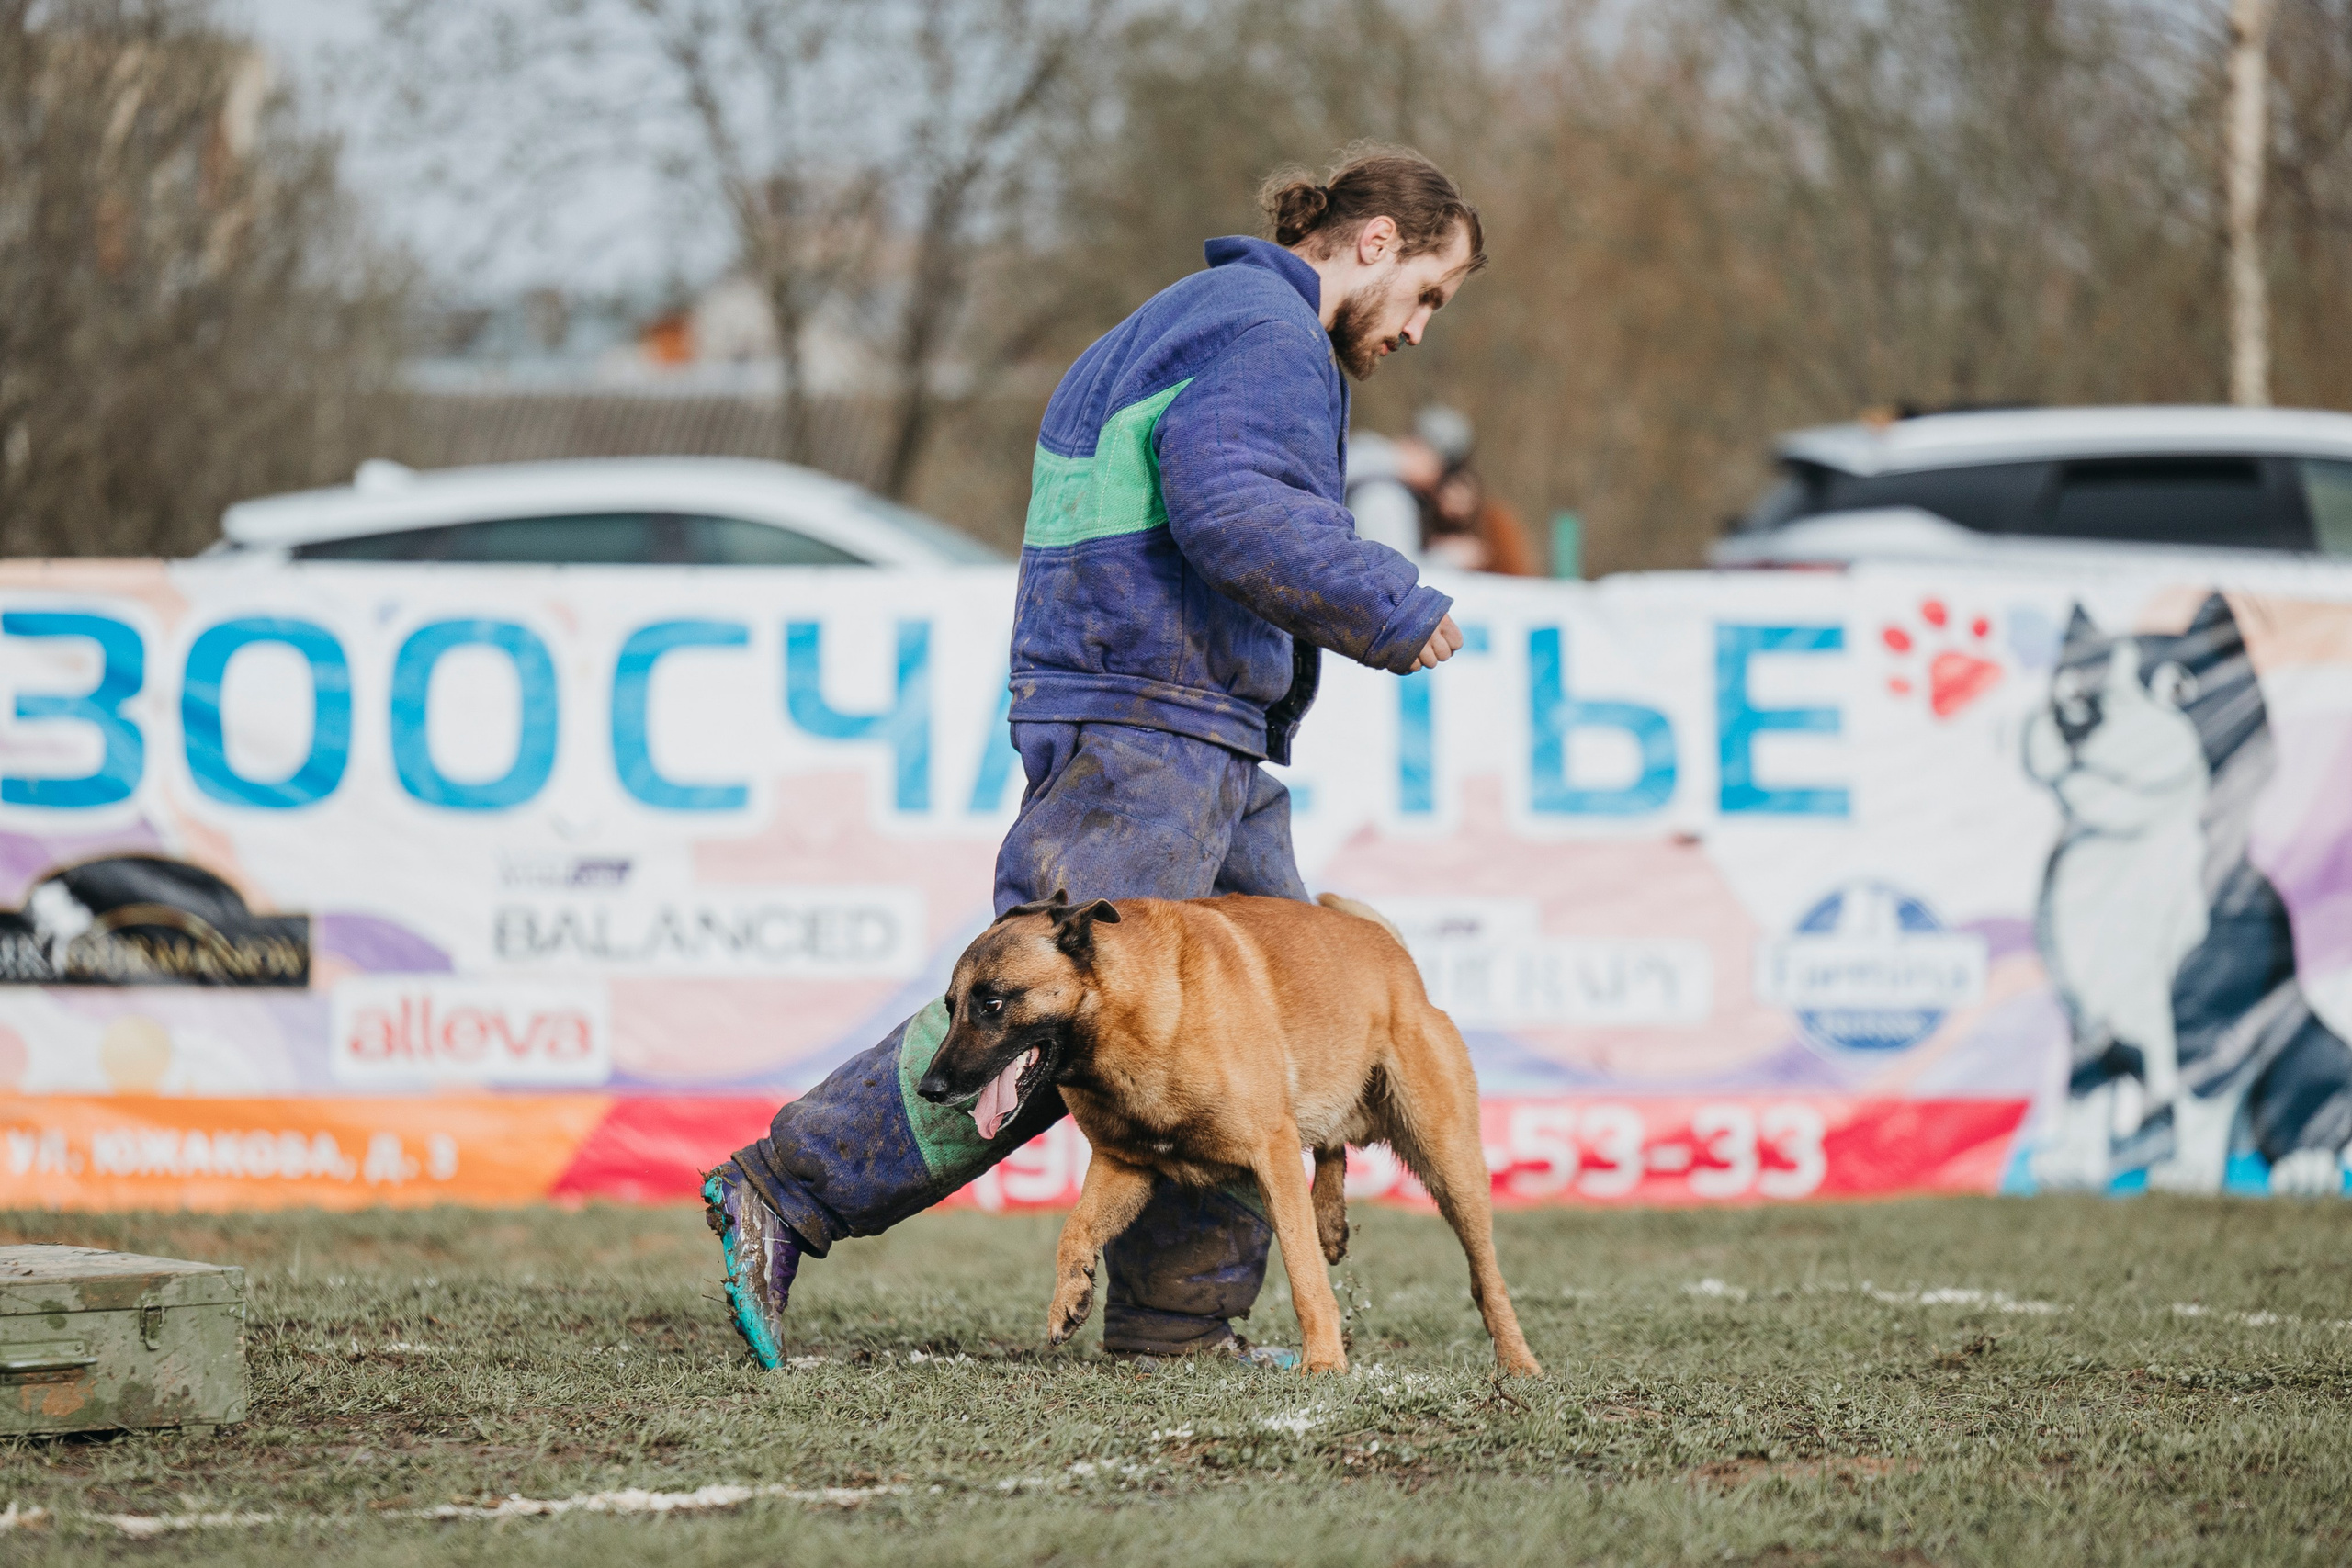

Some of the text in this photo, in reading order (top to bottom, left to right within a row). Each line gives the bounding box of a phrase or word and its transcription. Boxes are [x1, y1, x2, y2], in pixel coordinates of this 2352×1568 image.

[0, 613, 1850, 814] ЗООСЧТЬЕ
[496, 905, 897, 956] BALANCED
[348, 997, 591, 1061] alleva
